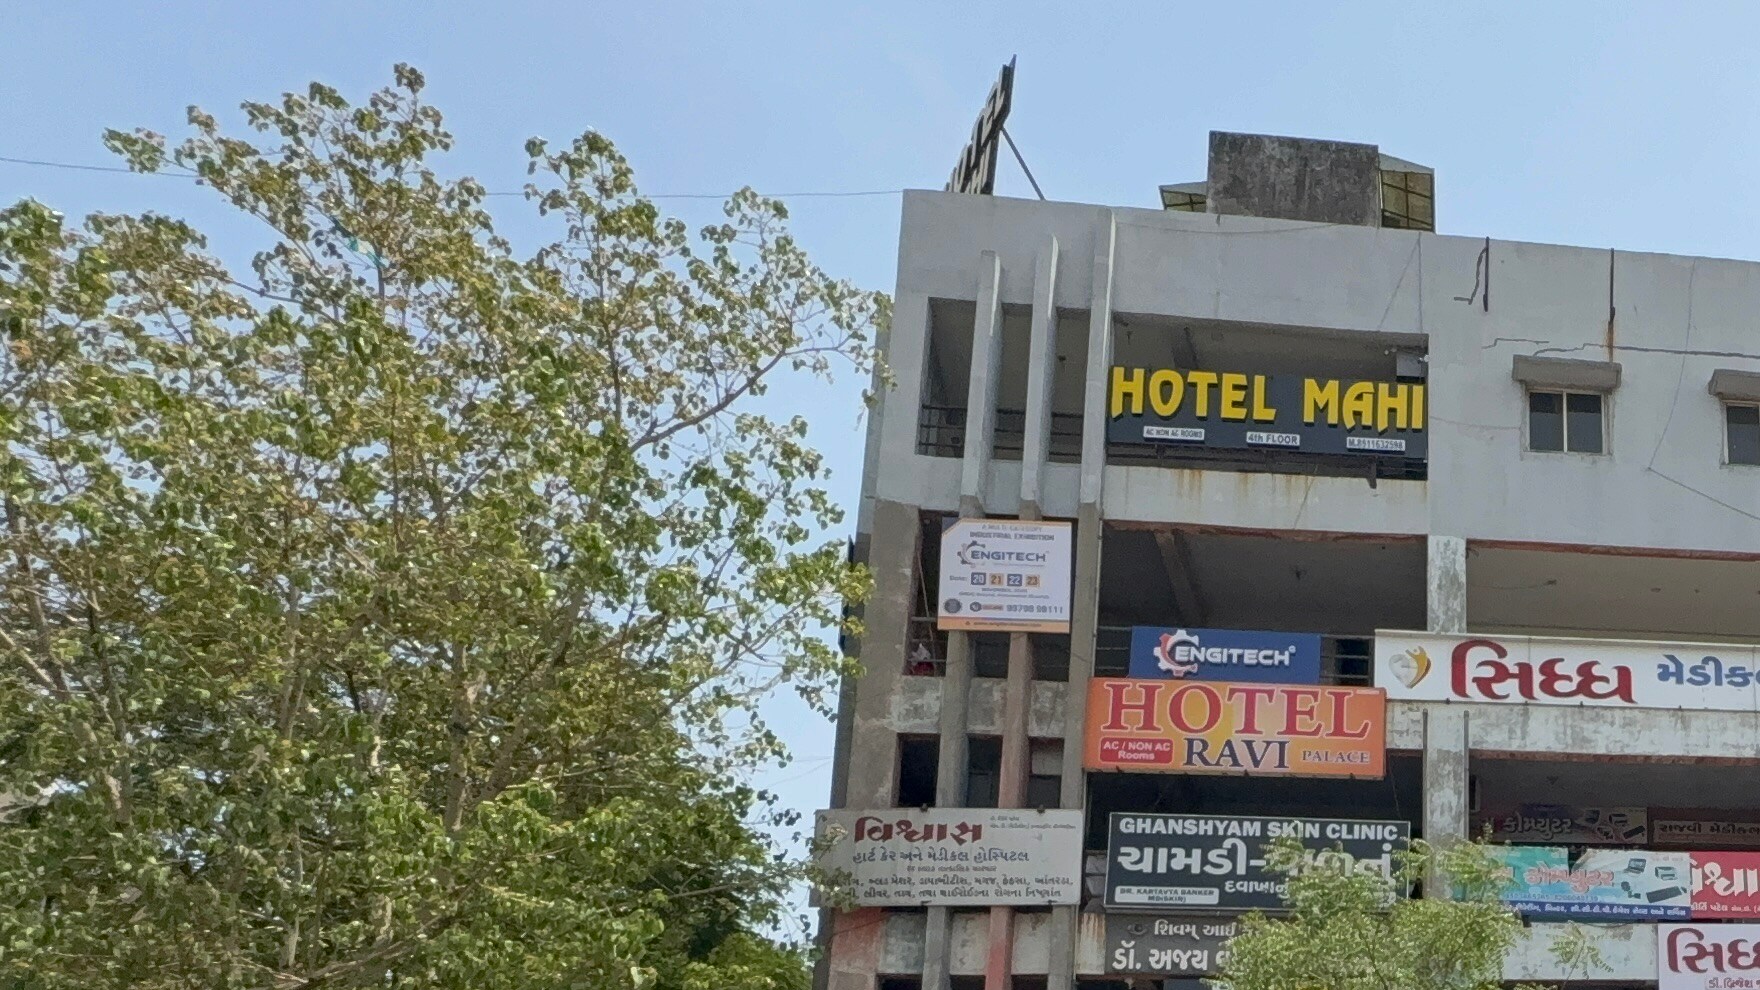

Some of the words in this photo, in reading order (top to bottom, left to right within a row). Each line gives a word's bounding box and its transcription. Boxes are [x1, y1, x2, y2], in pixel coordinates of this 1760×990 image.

[1111, 366, 1277, 421] HOTEL
[1303, 378, 1424, 433] MAHI
[1248, 433, 1263, 443] 4th
[1266, 434, 1298, 445] FLOOR
[970, 550, 1046, 562] ENGITECH
[1008, 575, 1021, 585] 22
[1175, 645, 1290, 667] ENGITECH
[1101, 682, 1373, 739] HOTEL
[1103, 741, 1120, 751] AC
[1128, 741, 1154, 751] NON
[1155, 742, 1171, 752] AC
[1118, 750, 1156, 761] Rooms
[1182, 737, 1290, 769] RAVI
[1301, 749, 1370, 764] PALACE
[854, 815, 984, 846] વિશ્વાસ
[1119, 818, 1261, 837] GHANSHYAM
[1267, 820, 1320, 839] SKIN
[1326, 822, 1399, 841] CLINIC
[853, 847, 876, 863] હાર્ટ
[879, 846, 897, 862] કેર
[899, 847, 923, 862] અને
[927, 846, 969, 862] મેડીકલ
[973, 847, 1030, 864] હોસ્પિટલ
[1154, 918, 1200, 940] શિવમ્
[1149, 947, 1208, 971] અજય
